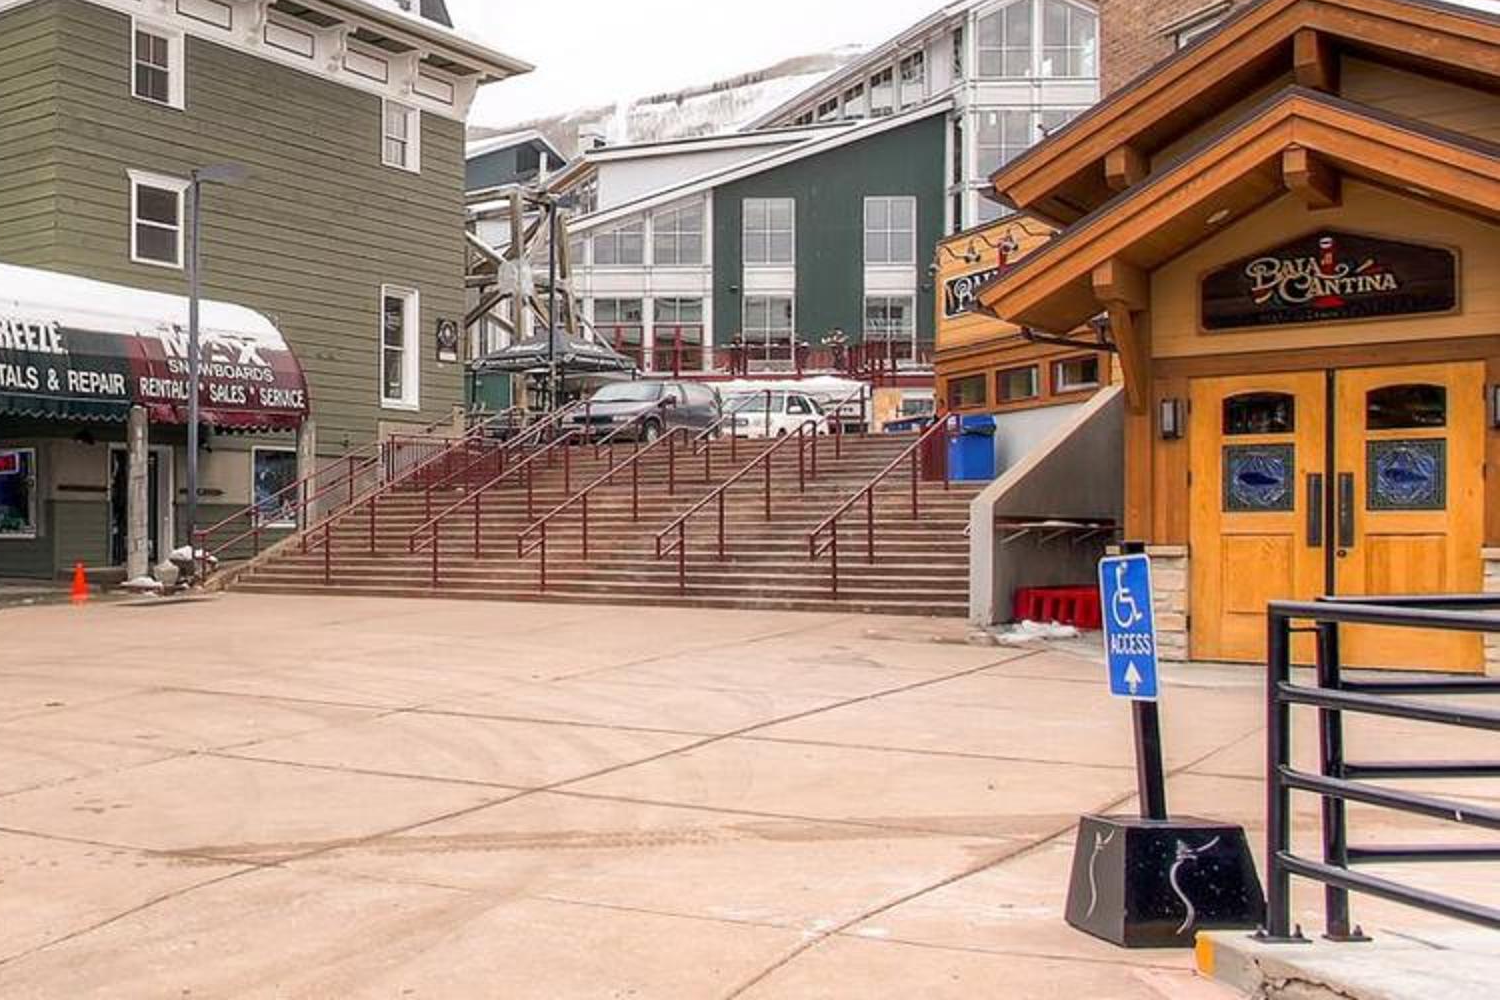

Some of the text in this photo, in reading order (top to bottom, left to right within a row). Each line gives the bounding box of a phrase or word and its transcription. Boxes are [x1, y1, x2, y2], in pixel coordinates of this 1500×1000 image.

[47, 368, 60, 391] &
[68, 370, 126, 395] REPAIR
[167, 359, 275, 383] SNWBOARDS
[209, 383, 247, 404] SALES
[259, 387, 306, 408] SERVICE
[1110, 632, 1152, 656] ACCESS
